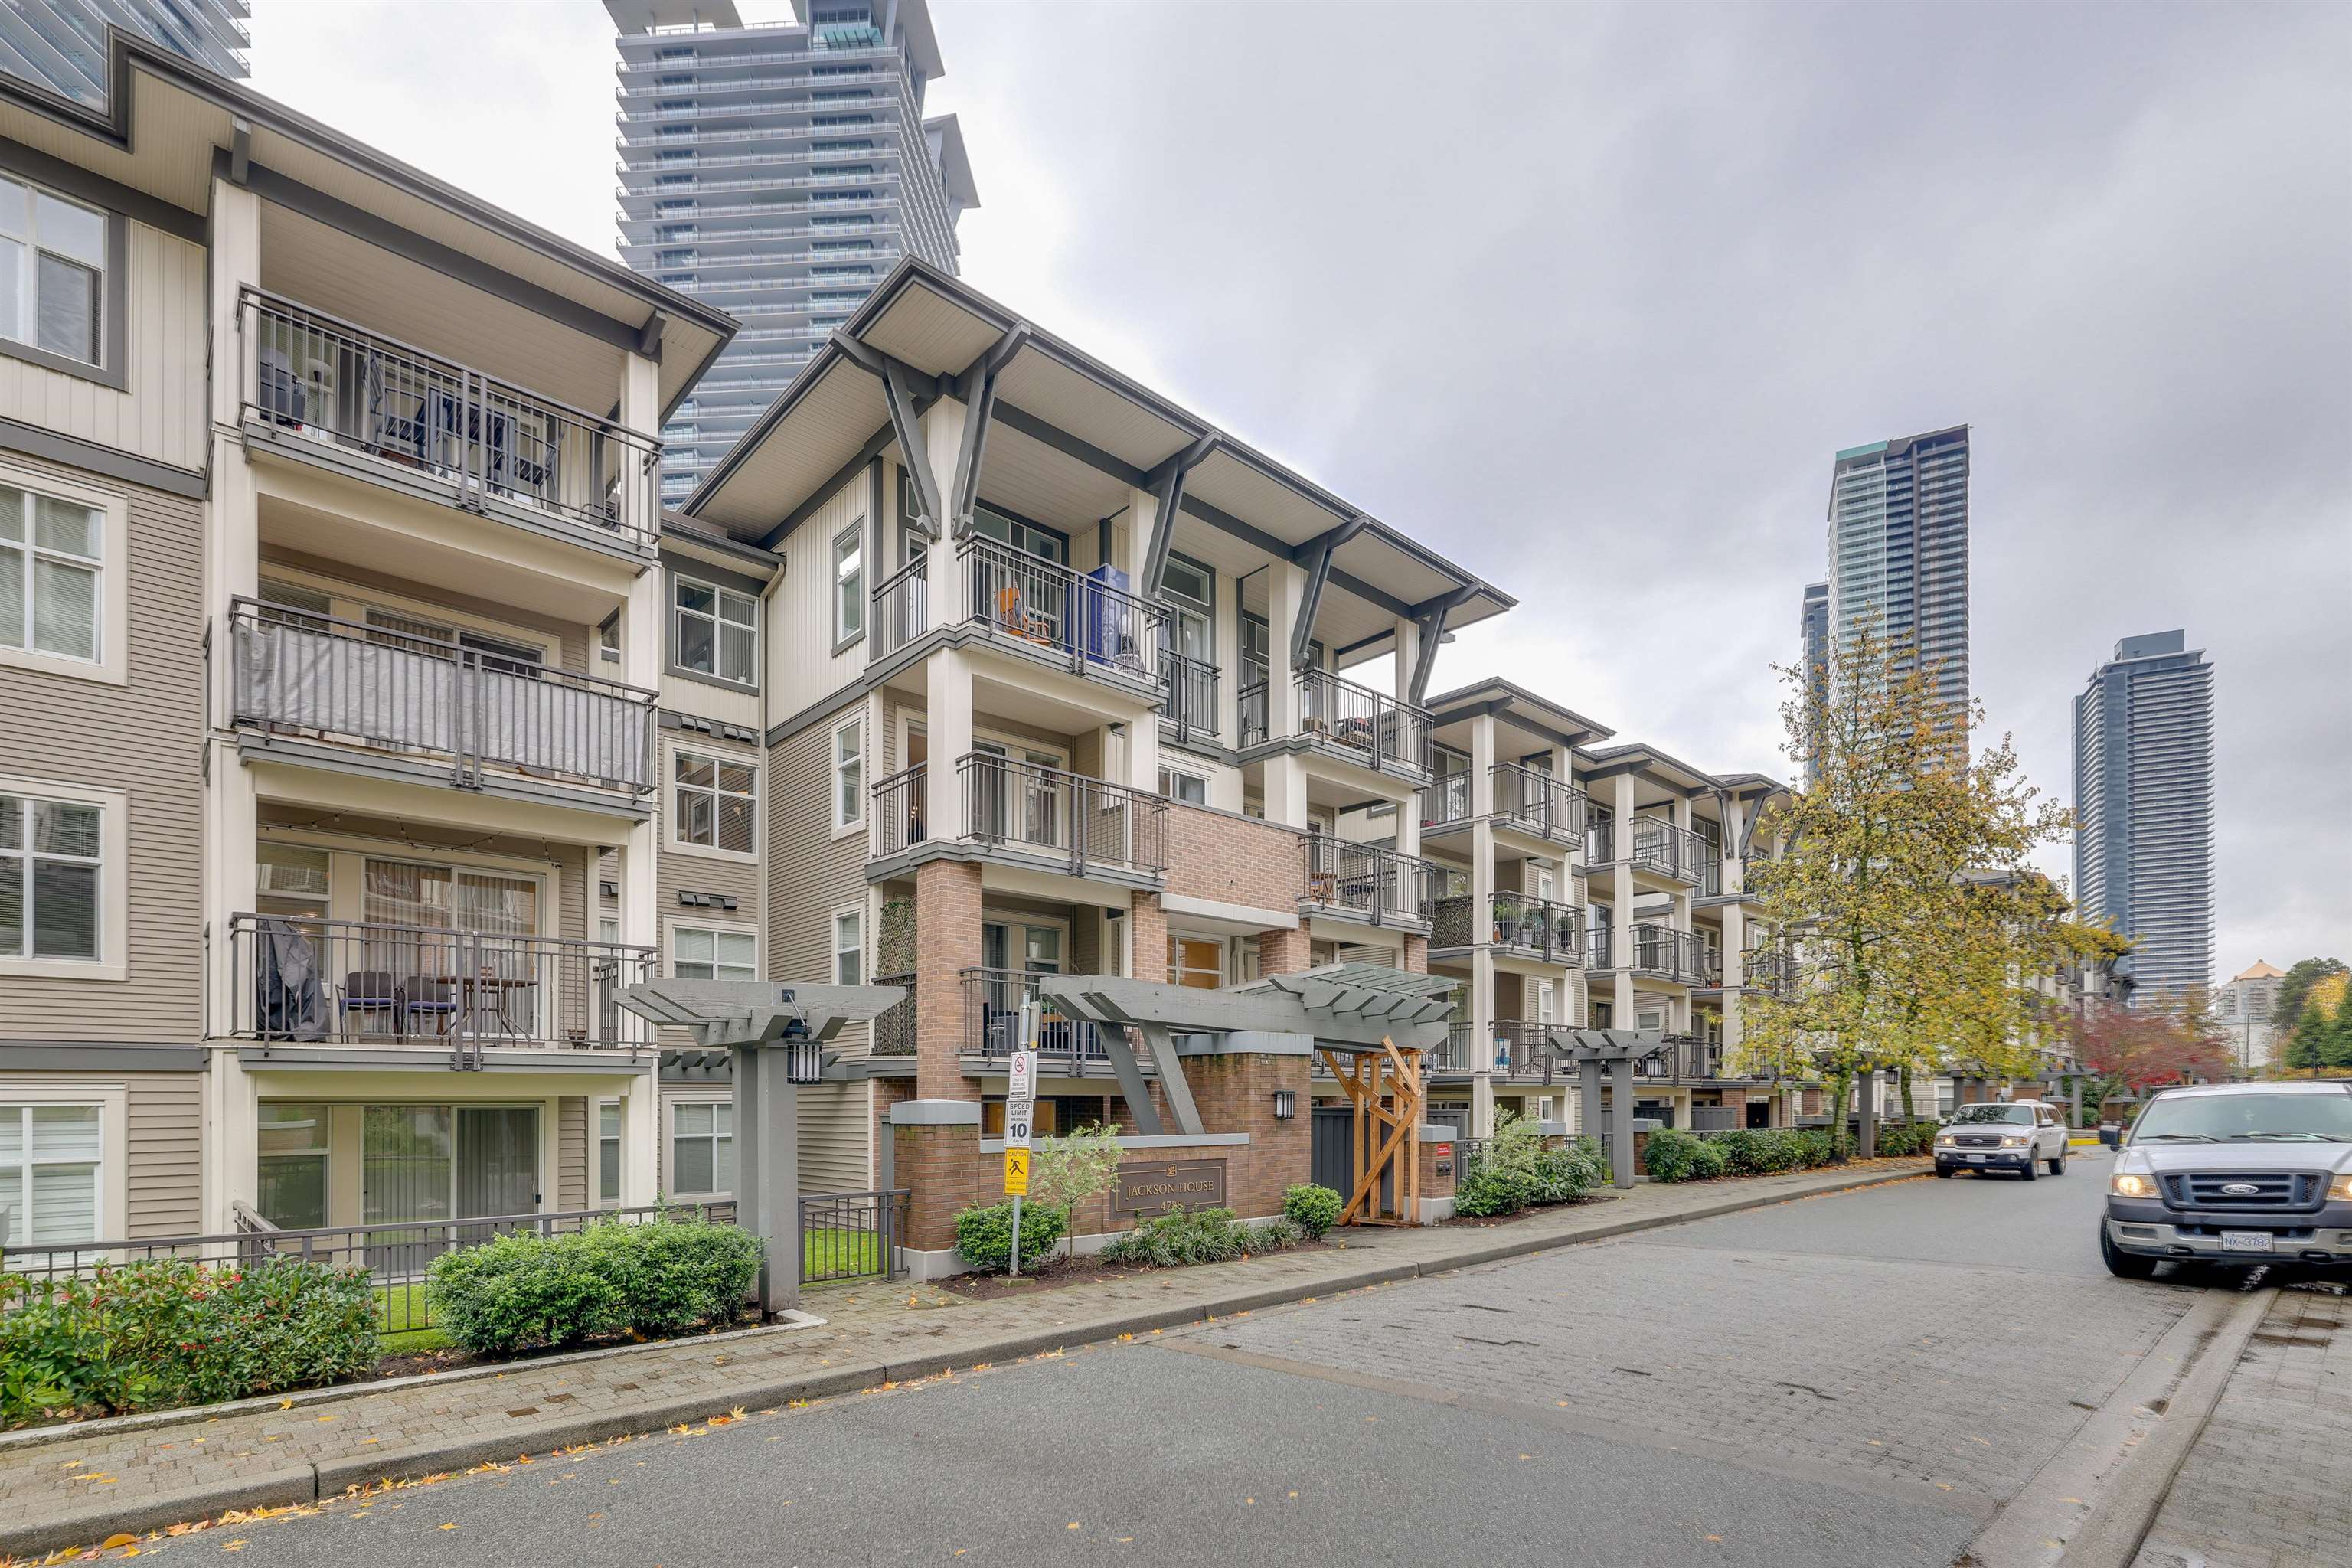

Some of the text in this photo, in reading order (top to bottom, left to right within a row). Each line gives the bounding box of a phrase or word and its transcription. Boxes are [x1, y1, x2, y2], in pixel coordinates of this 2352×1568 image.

[1010, 1123, 1027, 1138] 10
[1125, 1181, 1214, 1200] JACKSON HOUSE
[1161, 1200, 1184, 1211] 4788
